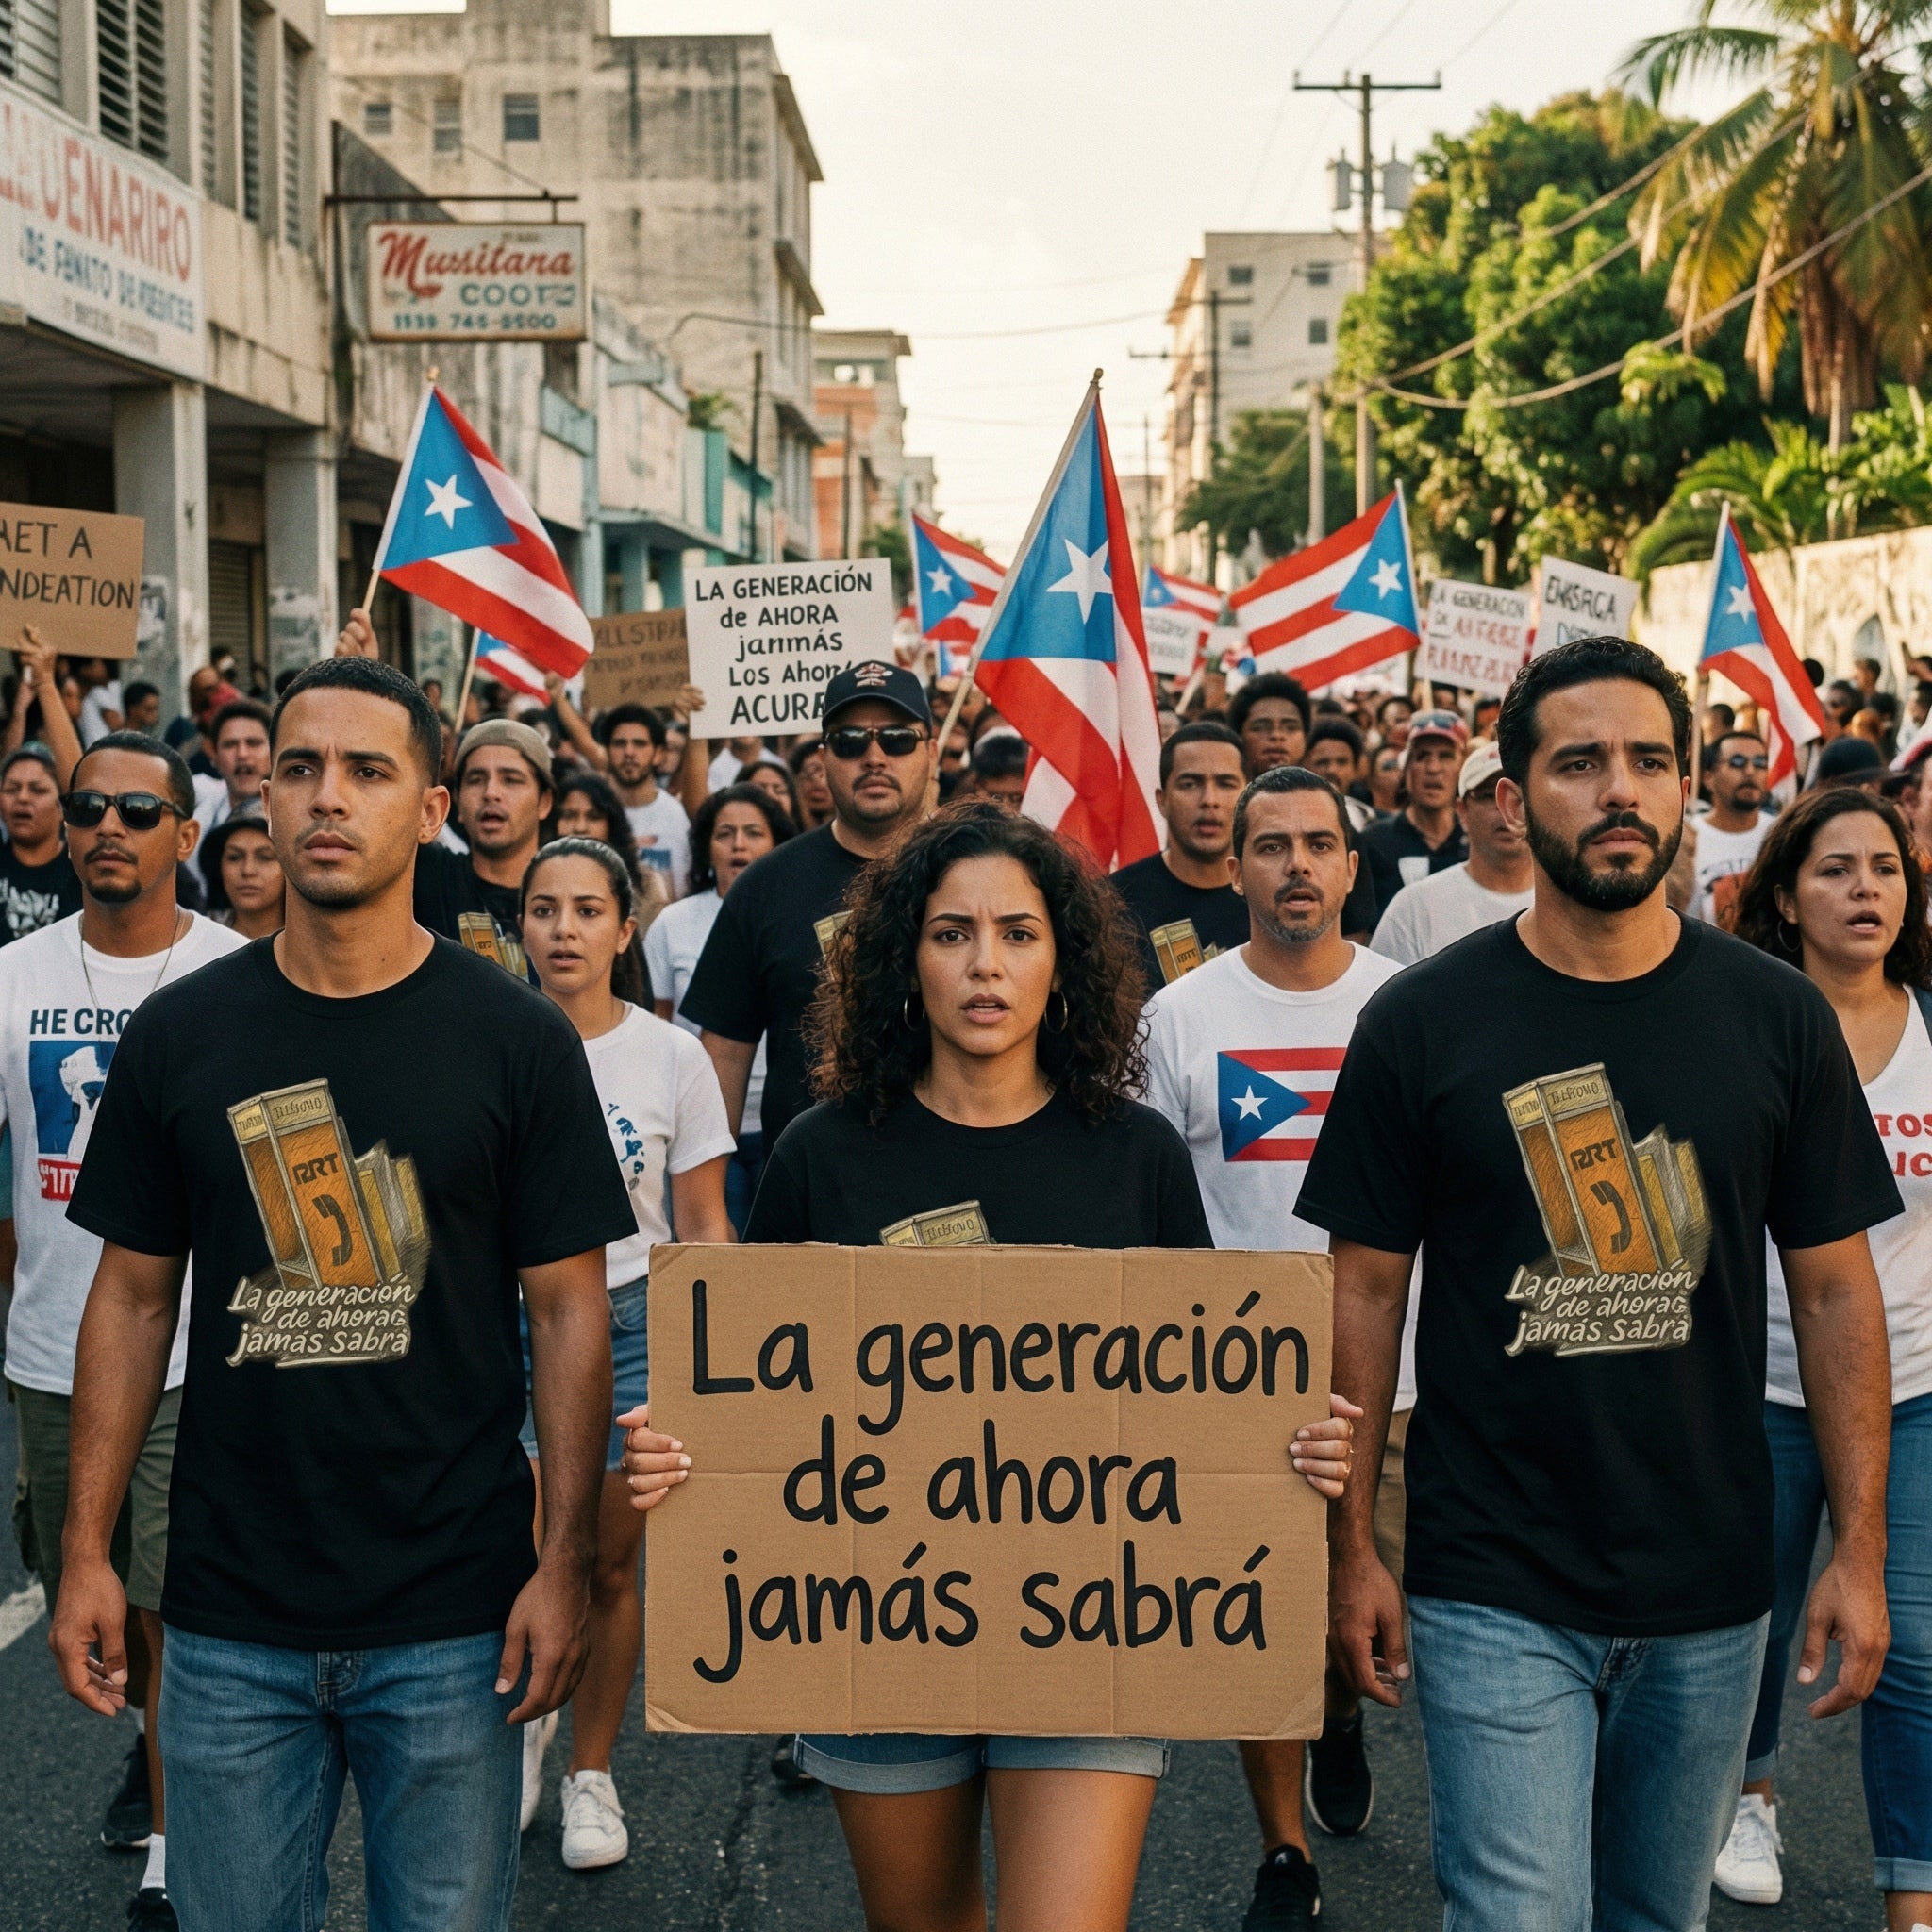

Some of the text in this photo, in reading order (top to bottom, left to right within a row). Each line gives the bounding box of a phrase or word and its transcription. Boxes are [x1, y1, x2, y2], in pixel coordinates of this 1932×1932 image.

[68, 526, 92, 559] A
[695, 578, 724, 602] LA
[720, 604, 839, 628] de AHORA
[30, 1009, 68, 1035] HE
[227, 1272, 416, 1324] La generación
[1504, 1258, 1697, 1312] La generación
[1556, 1293, 1591, 1319] de
[277, 1307, 312, 1330] de
[1504, 1312, 1602, 1357] jamás
[226, 1323, 324, 1368] jamás
[692, 1279, 1309, 1435] La generación
[783, 1414, 1181, 1524] de ahora
[692, 1540, 1270, 1683] jamás sabrá
